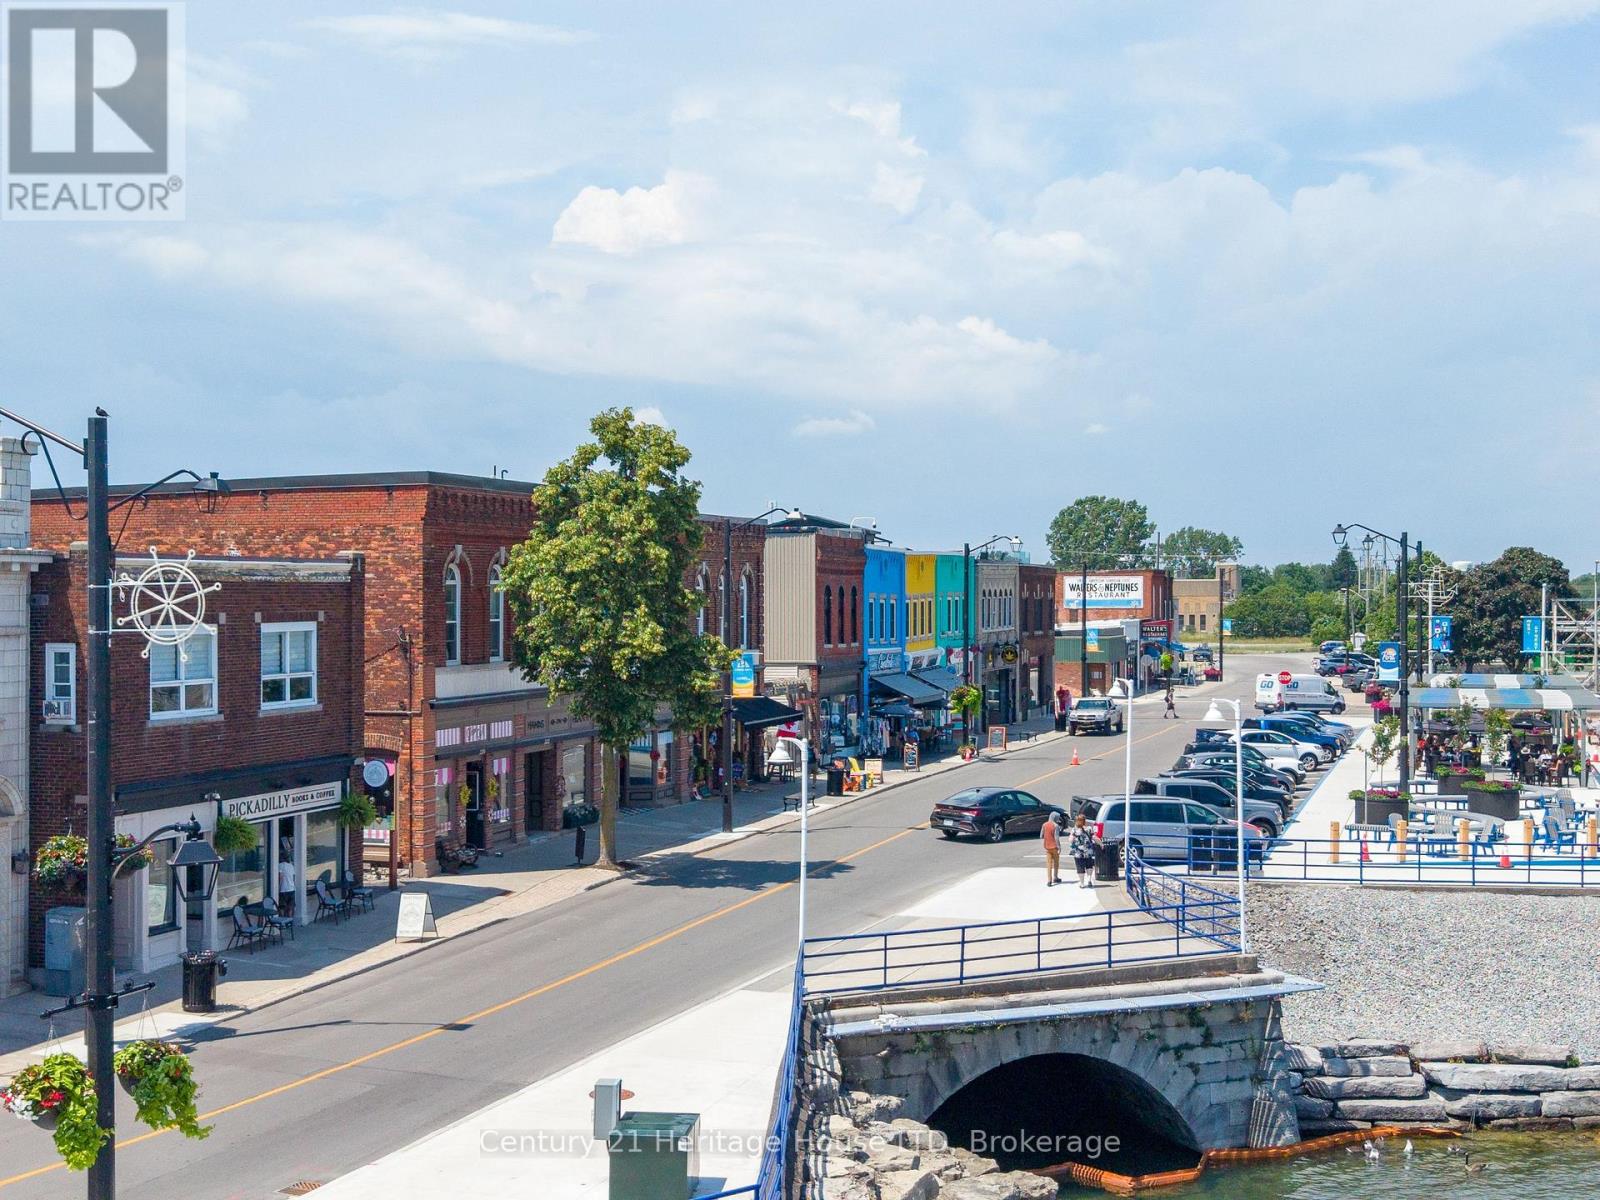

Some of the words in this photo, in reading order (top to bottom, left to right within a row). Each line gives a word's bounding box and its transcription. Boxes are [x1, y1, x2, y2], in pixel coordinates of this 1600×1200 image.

[1104, 582, 1139, 592] NEPTUNES
[1260, 681, 1274, 689] GO
[229, 794, 291, 817] PICKADILLY
[292, 794, 309, 803] BOOKS
[316, 790, 335, 799] COFFEE
